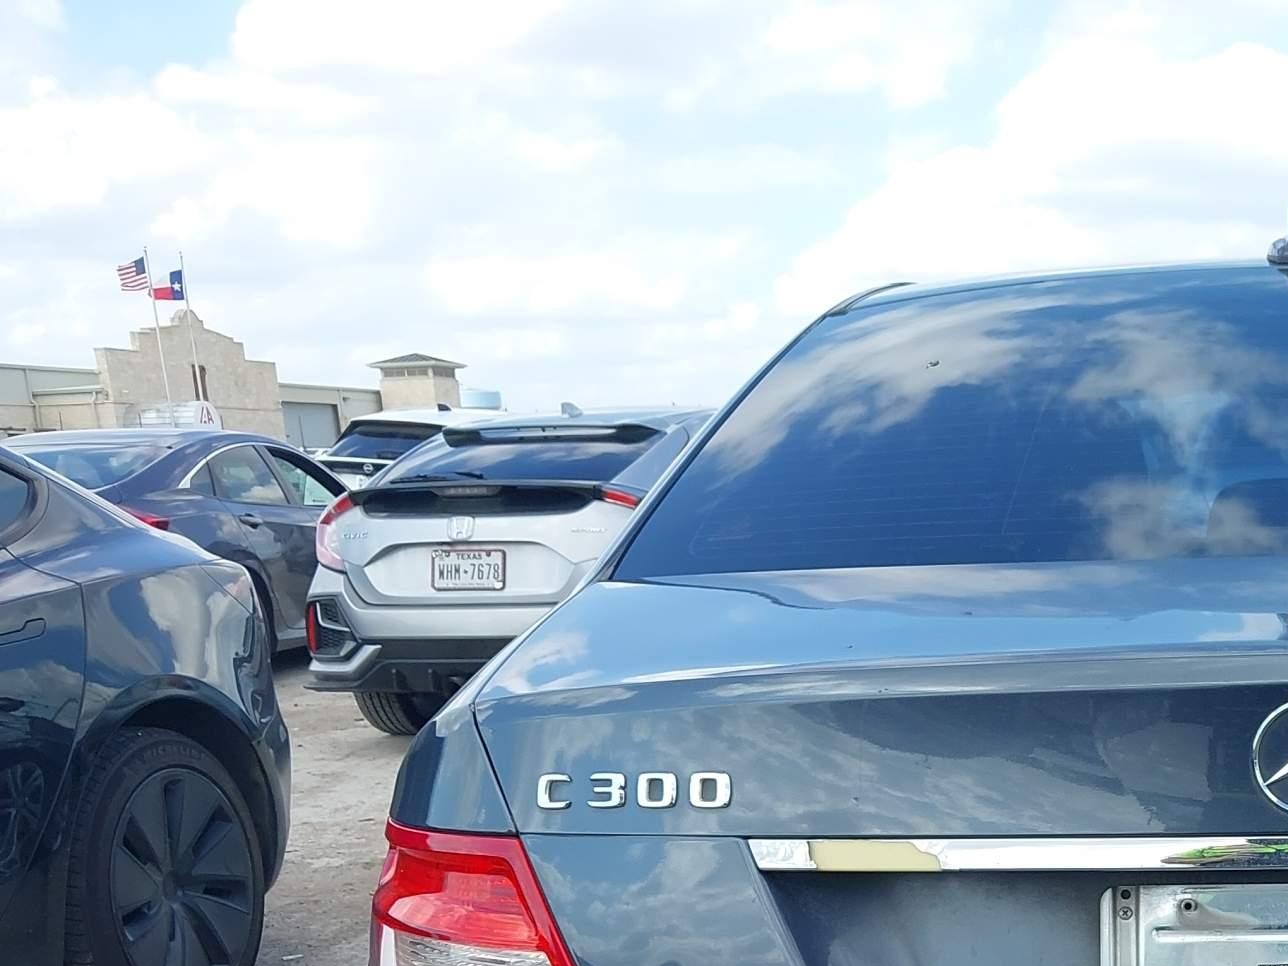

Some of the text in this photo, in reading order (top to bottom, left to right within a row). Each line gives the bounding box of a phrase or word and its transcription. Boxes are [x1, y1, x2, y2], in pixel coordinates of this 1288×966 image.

[456, 552, 482, 560] TEXAS
[537, 771, 732, 809] C 300
